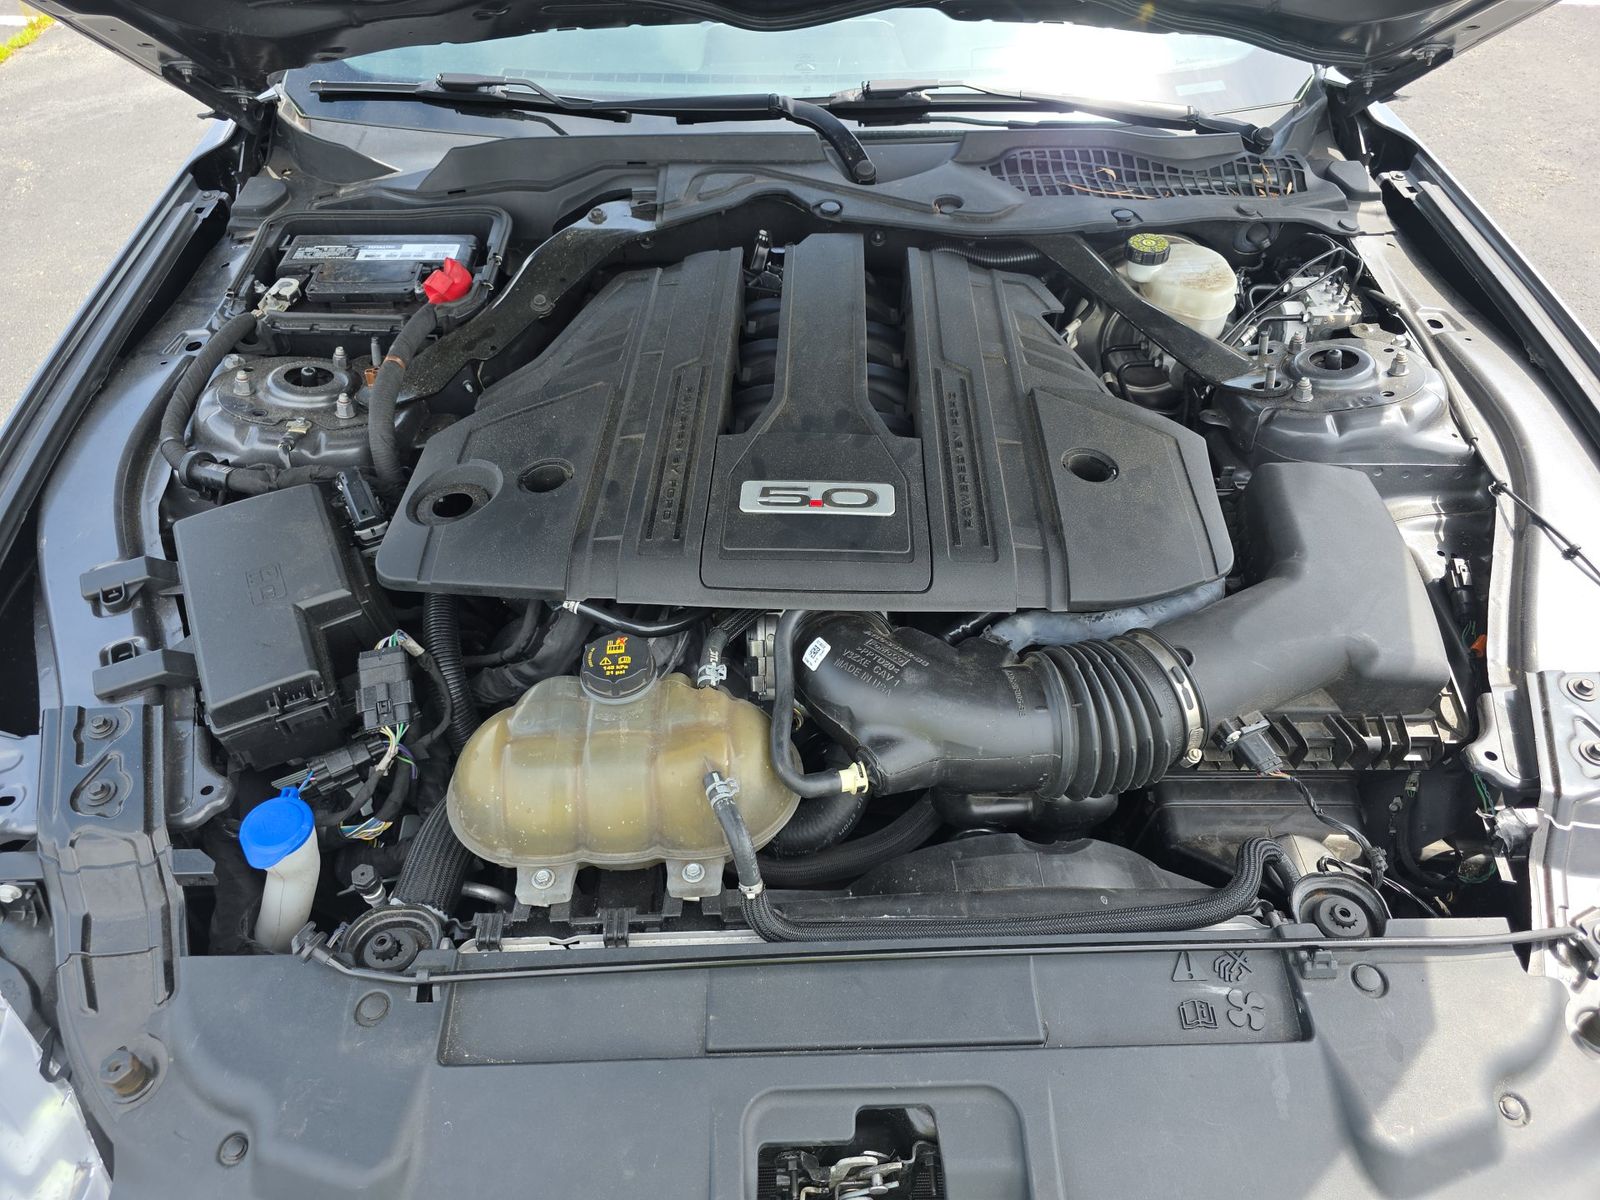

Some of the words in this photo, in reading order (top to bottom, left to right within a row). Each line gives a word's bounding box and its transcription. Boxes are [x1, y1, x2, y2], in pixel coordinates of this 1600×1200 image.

[670, 454, 682, 475] BY
[662, 479, 678, 521] FORD
[757, 486, 878, 508] 5.0
[833, 658, 862, 677] MADE
[860, 671, 873, 683] IN
[872, 678, 892, 697] USA
[873, 665, 894, 681] CAV
